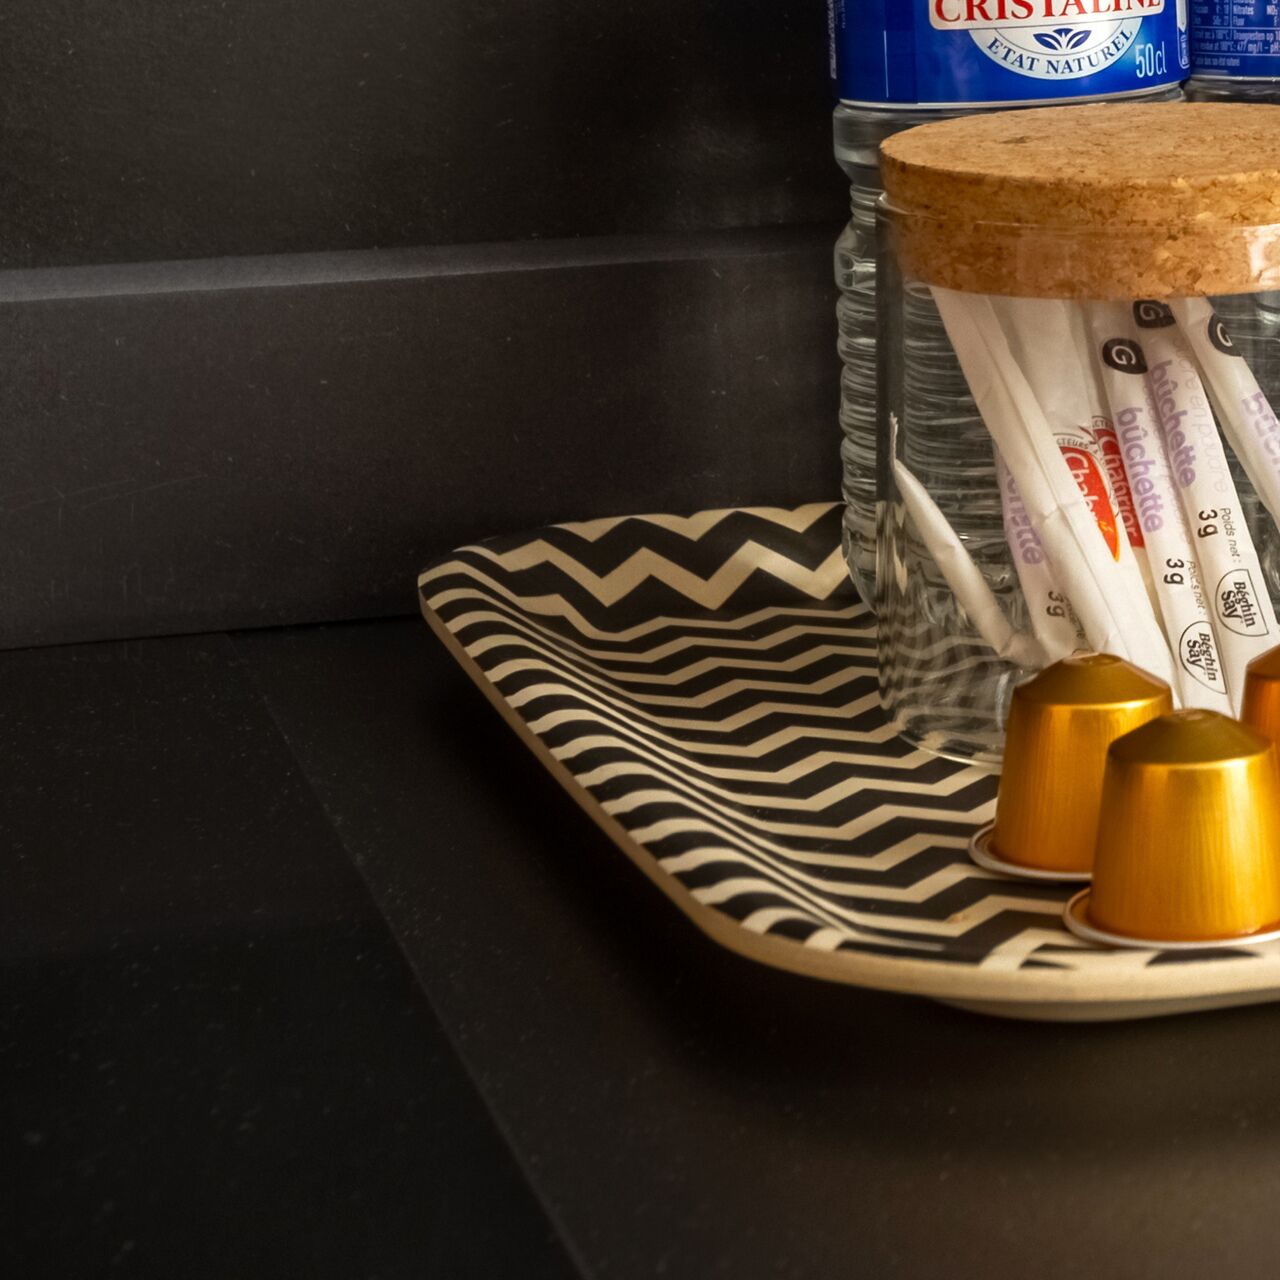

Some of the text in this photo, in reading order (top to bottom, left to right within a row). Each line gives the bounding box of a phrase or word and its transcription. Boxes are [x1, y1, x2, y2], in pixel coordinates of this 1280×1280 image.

[986, 36, 1040, 72] ETAT
[1046, 28, 1133, 75] NATUREL
[1134, 40, 1168, 79] 50cl
[1150, 359, 1197, 489] bûchette
[1115, 406, 1164, 534] bûchette
[1220, 590, 1243, 622] Say
[1233, 581, 1258, 628] Béghin
[1186, 638, 1207, 671] Say
[1198, 631, 1217, 682] Béghin
